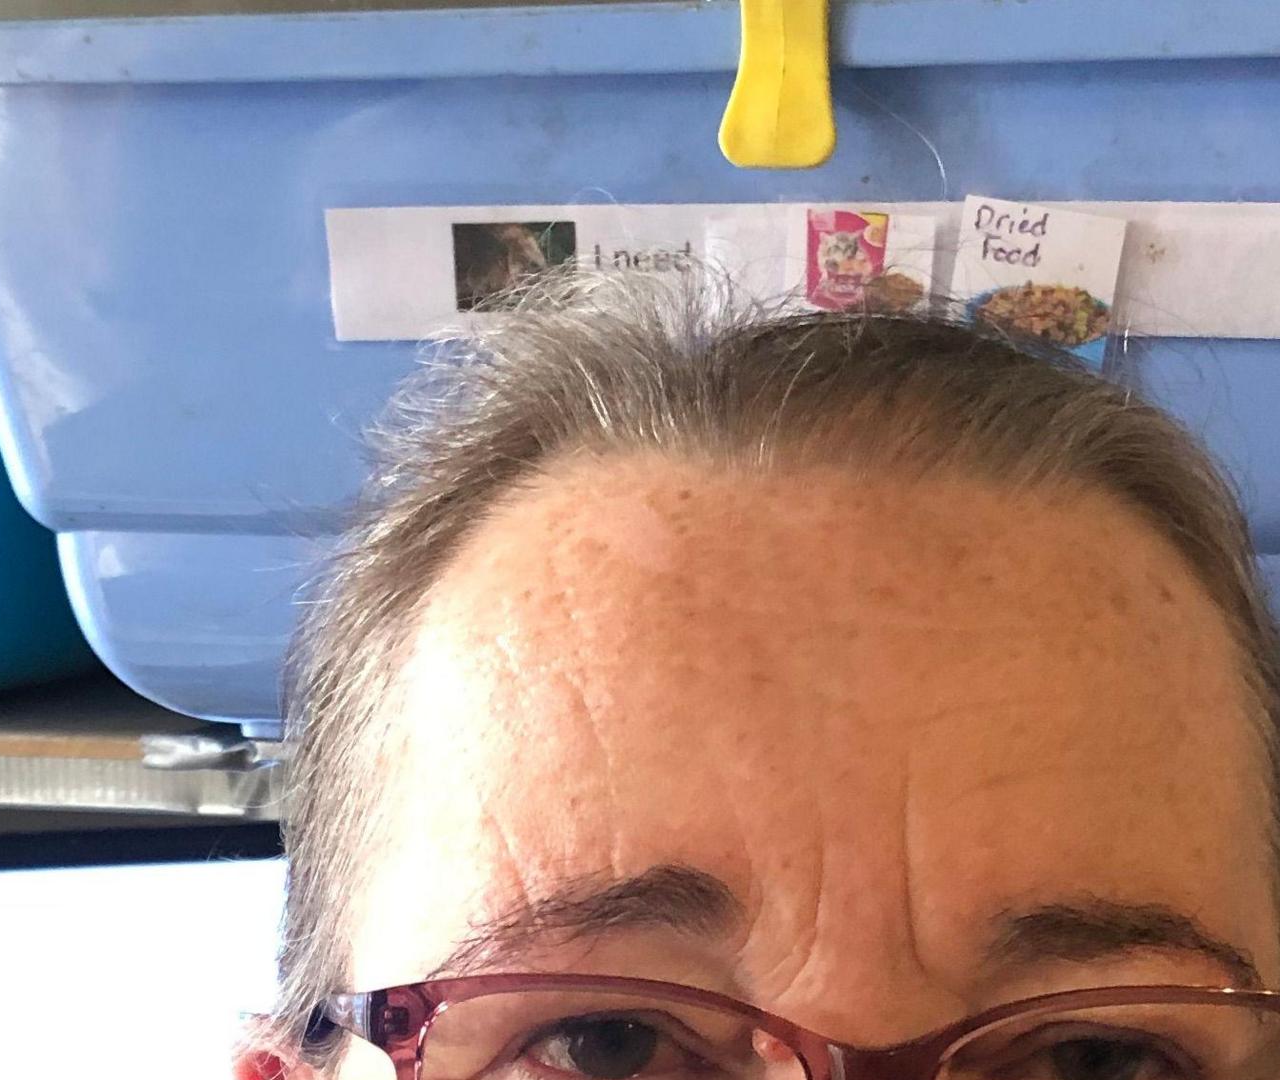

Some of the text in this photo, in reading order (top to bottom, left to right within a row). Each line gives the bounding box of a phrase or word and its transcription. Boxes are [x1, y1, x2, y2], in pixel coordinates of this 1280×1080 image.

[974, 204, 1050, 237] Dried
[613, 241, 691, 272] need
[981, 236, 1042, 268] Food
